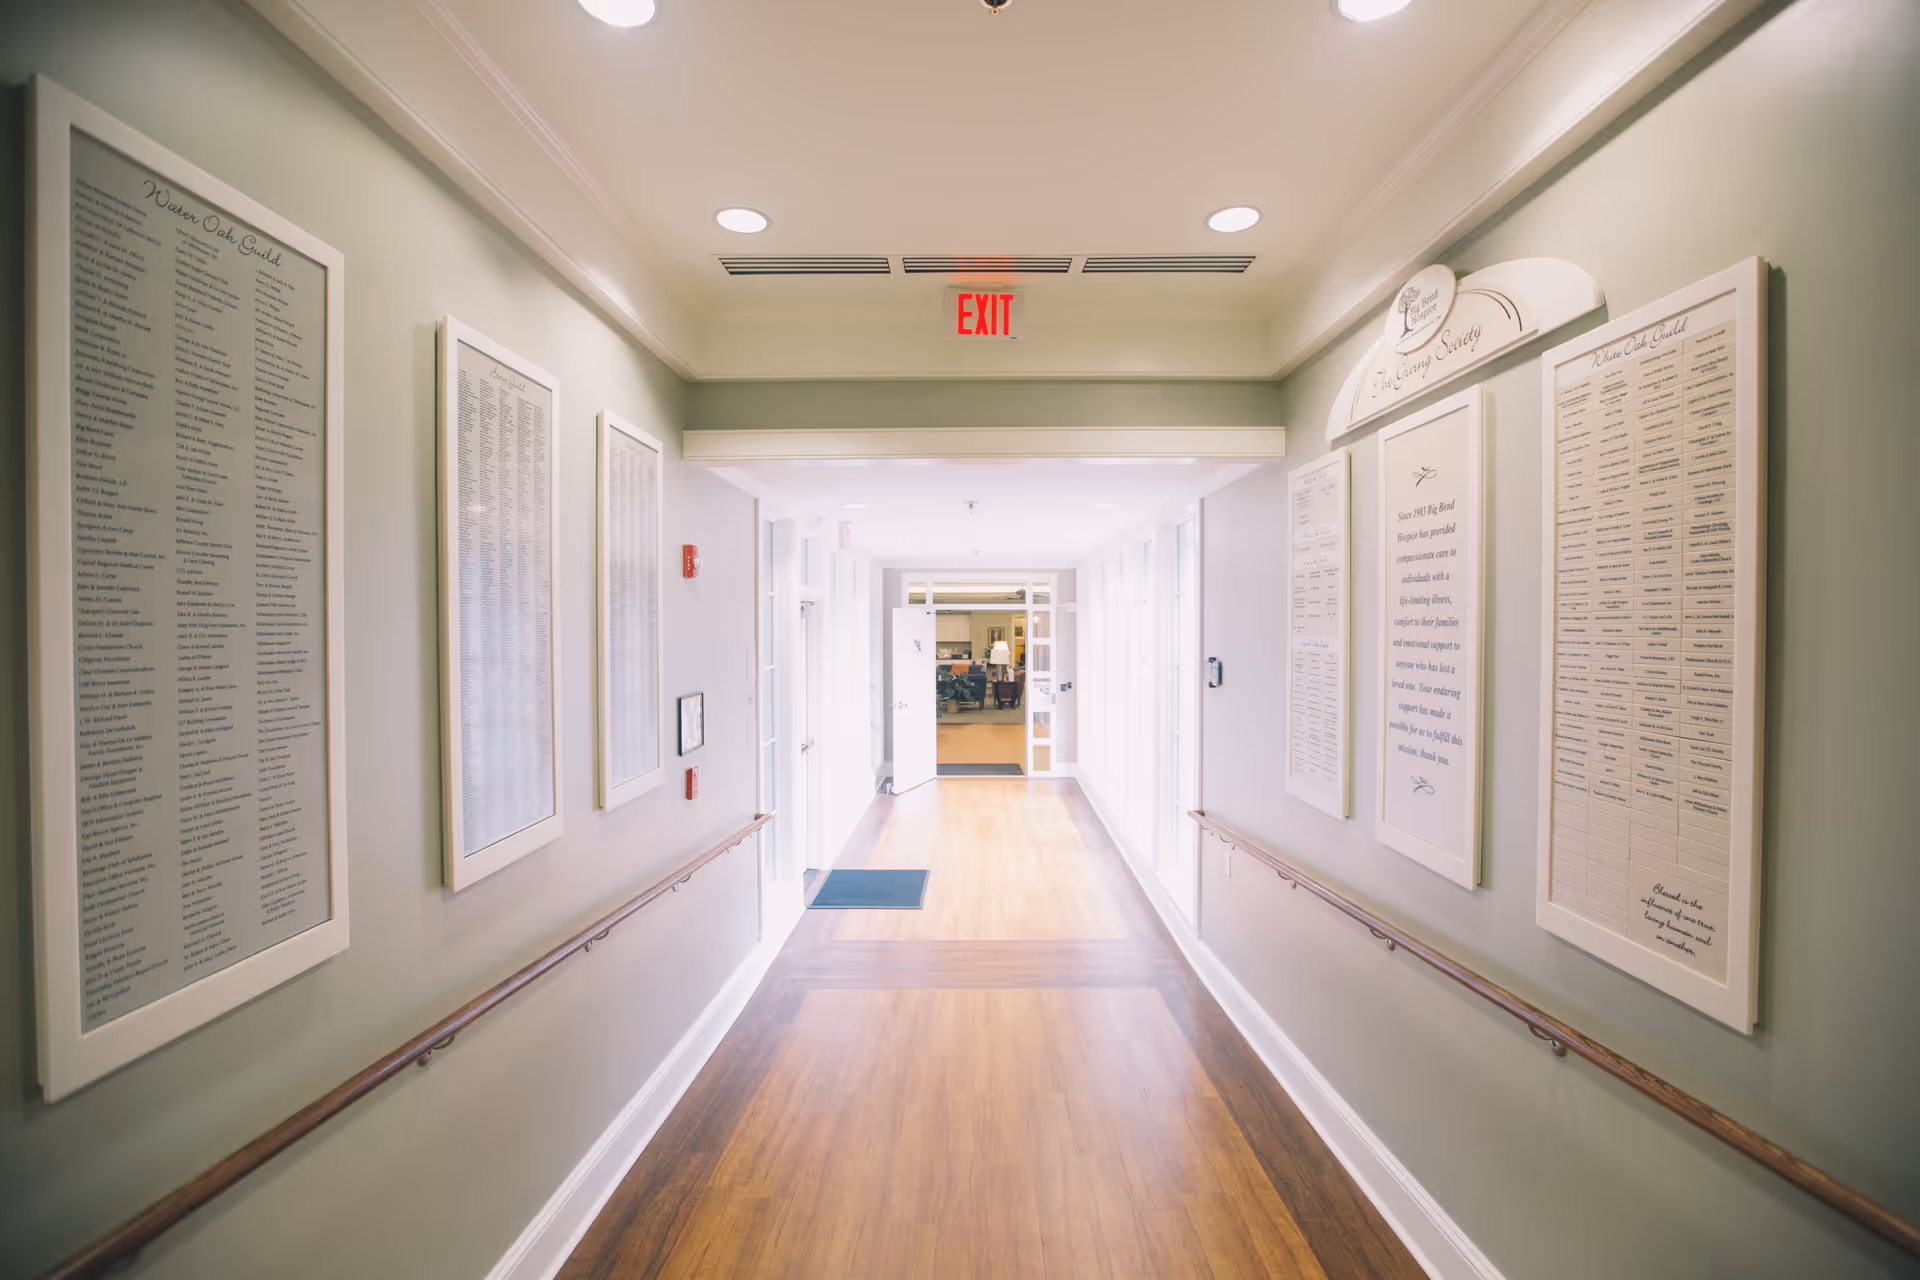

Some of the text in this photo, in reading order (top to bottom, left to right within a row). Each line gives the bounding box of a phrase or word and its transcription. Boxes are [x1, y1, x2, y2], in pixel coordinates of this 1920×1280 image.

[143, 180, 281, 267] Water Oak Guild
[1409, 288, 1439, 316] Big Bend
[957, 293, 1015, 336] EXIT
[1410, 303, 1438, 325] Hospice
[1591, 316, 1688, 368] White Oak Guild
[1372, 324, 1484, 398] The Giving Society
[1397, 511, 1412, 522] Since
[1427, 504, 1438, 516] Big
[1438, 499, 1455, 513] Bend
[1397, 523, 1456, 544] Hospice has provided
[1435, 550, 1449, 559] care
[1449, 548, 1457, 557] to
[1401, 571, 1450, 584] individuals with a
[1431, 593, 1453, 606] illness,
[1393, 616, 1459, 630] comfort to their families
[1392, 637, 1461, 653] and emotional support to
[1415, 660, 1427, 671] who
[1427, 660, 1438, 672] has
[1439, 662, 1451, 673] lost
[1450, 666, 1456, 674] a
[1405, 682, 1417, 691] one.
[1419, 682, 1433, 694] Your
[1433, 686, 1461, 701] enduring
[1398, 703, 1452, 721] support has made it
[1408, 723, 1419, 736] for
[1418, 729, 1426, 737] us
[1426, 729, 1433, 738] to
[1432, 729, 1451, 744] fulfill
[1450, 733, 1463, 746] this
[1419, 748, 1437, 762] thank
[1437, 755, 1450, 767] you.
[1652, 883, 1682, 902] Blessed
[1689, 899, 1704, 911] the
[1640, 896, 1717, 933] influence of one true,
[1644, 910, 1713, 947] loving human soul
